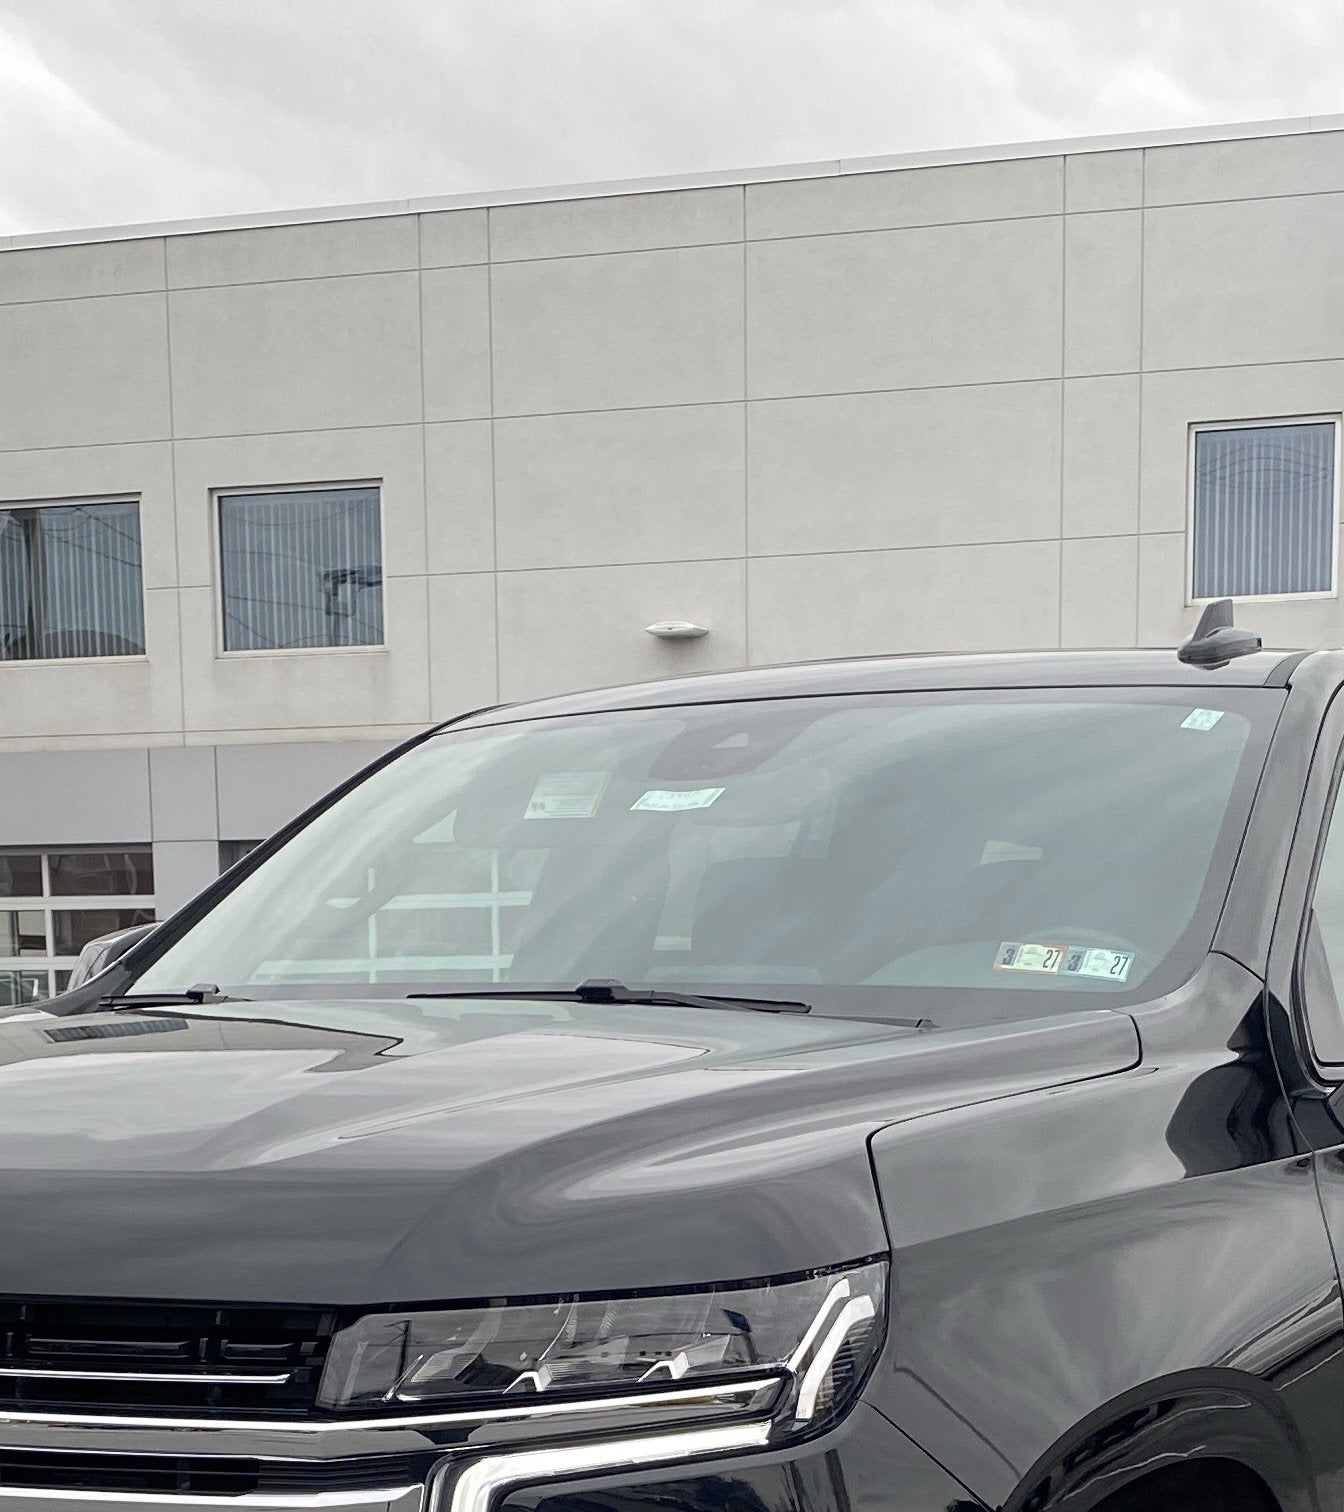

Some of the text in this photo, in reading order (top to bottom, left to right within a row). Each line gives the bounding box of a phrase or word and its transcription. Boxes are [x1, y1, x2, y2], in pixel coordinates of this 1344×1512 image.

[1001, 948, 1061, 969] 3 27
[1067, 954, 1129, 976] 3 27
